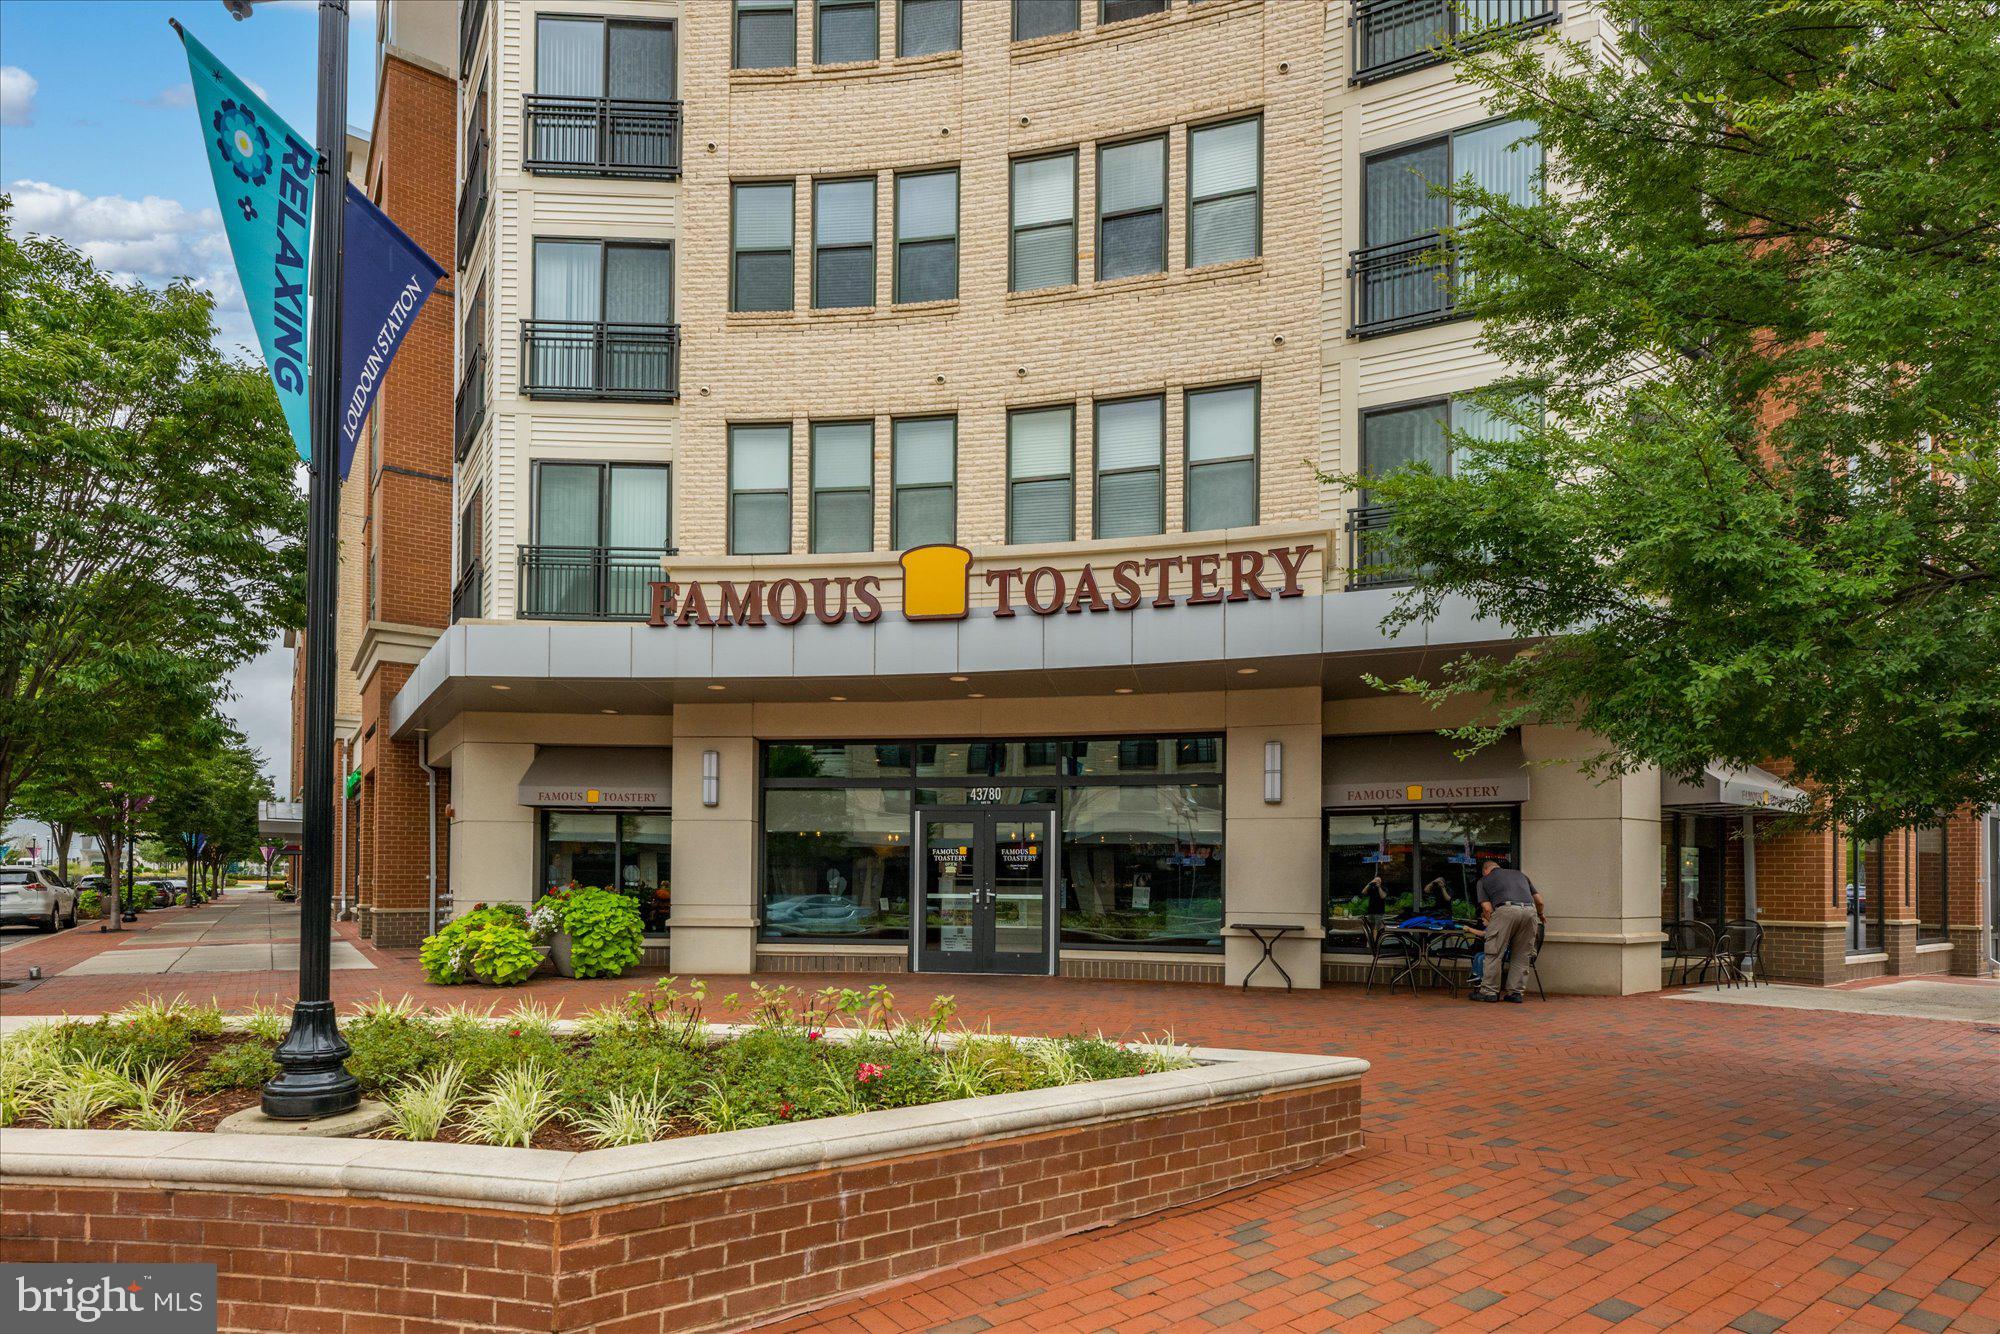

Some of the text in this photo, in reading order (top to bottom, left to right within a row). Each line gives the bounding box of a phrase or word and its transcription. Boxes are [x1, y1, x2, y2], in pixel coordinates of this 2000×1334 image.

[273, 133, 314, 397] RELAXING
[343, 274, 423, 442] LOUDOUN STATION
[646, 544, 1314, 627] FAMOUS TOASTERY
[538, 791, 657, 802] FAMOUS TOASTERY
[970, 787, 1001, 801] 43780
[1347, 785, 1499, 801] FAMOUS TOASTERY
